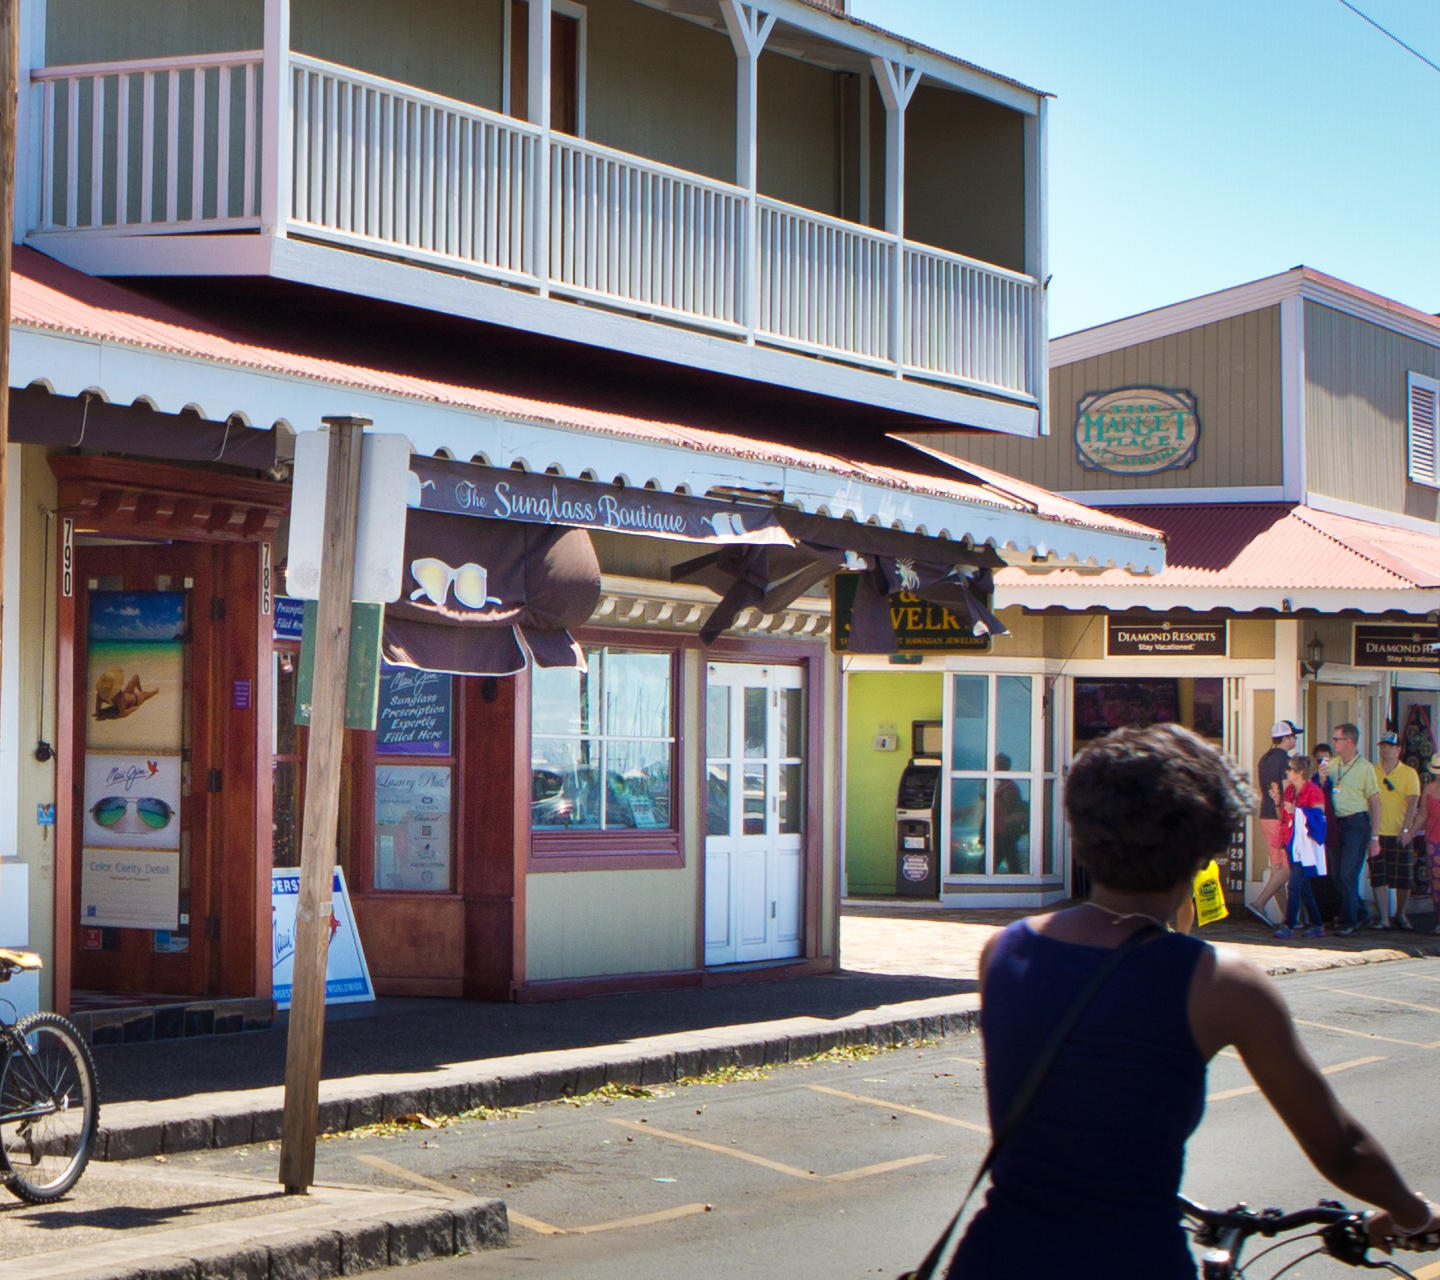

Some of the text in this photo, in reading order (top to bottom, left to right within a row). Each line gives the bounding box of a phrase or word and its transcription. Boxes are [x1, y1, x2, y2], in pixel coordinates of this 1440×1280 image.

[1110, 404, 1161, 414] THE
[1082, 411, 1191, 443] MARKET
[1105, 435, 1170, 450] PLACE
[1091, 446, 1107, 459] AT
[454, 480, 687, 535] The Sunglass Boutique
[63, 519, 72, 596] 790
[262, 543, 270, 613] 786
[905, 637, 943, 645] HAWAIIAN
[1118, 631, 1216, 642] DIAMOND RESORTS
[1138, 643, 1154, 652] Stay
[1366, 642, 1420, 654] DIAMOND
[389, 693, 438, 707] Sunglass
[381, 704, 445, 719] Prescription
[390, 716, 438, 731] Expertly
[383, 729, 443, 743] Filled Here
[326, 982, 364, 995] WORLDWIDE
